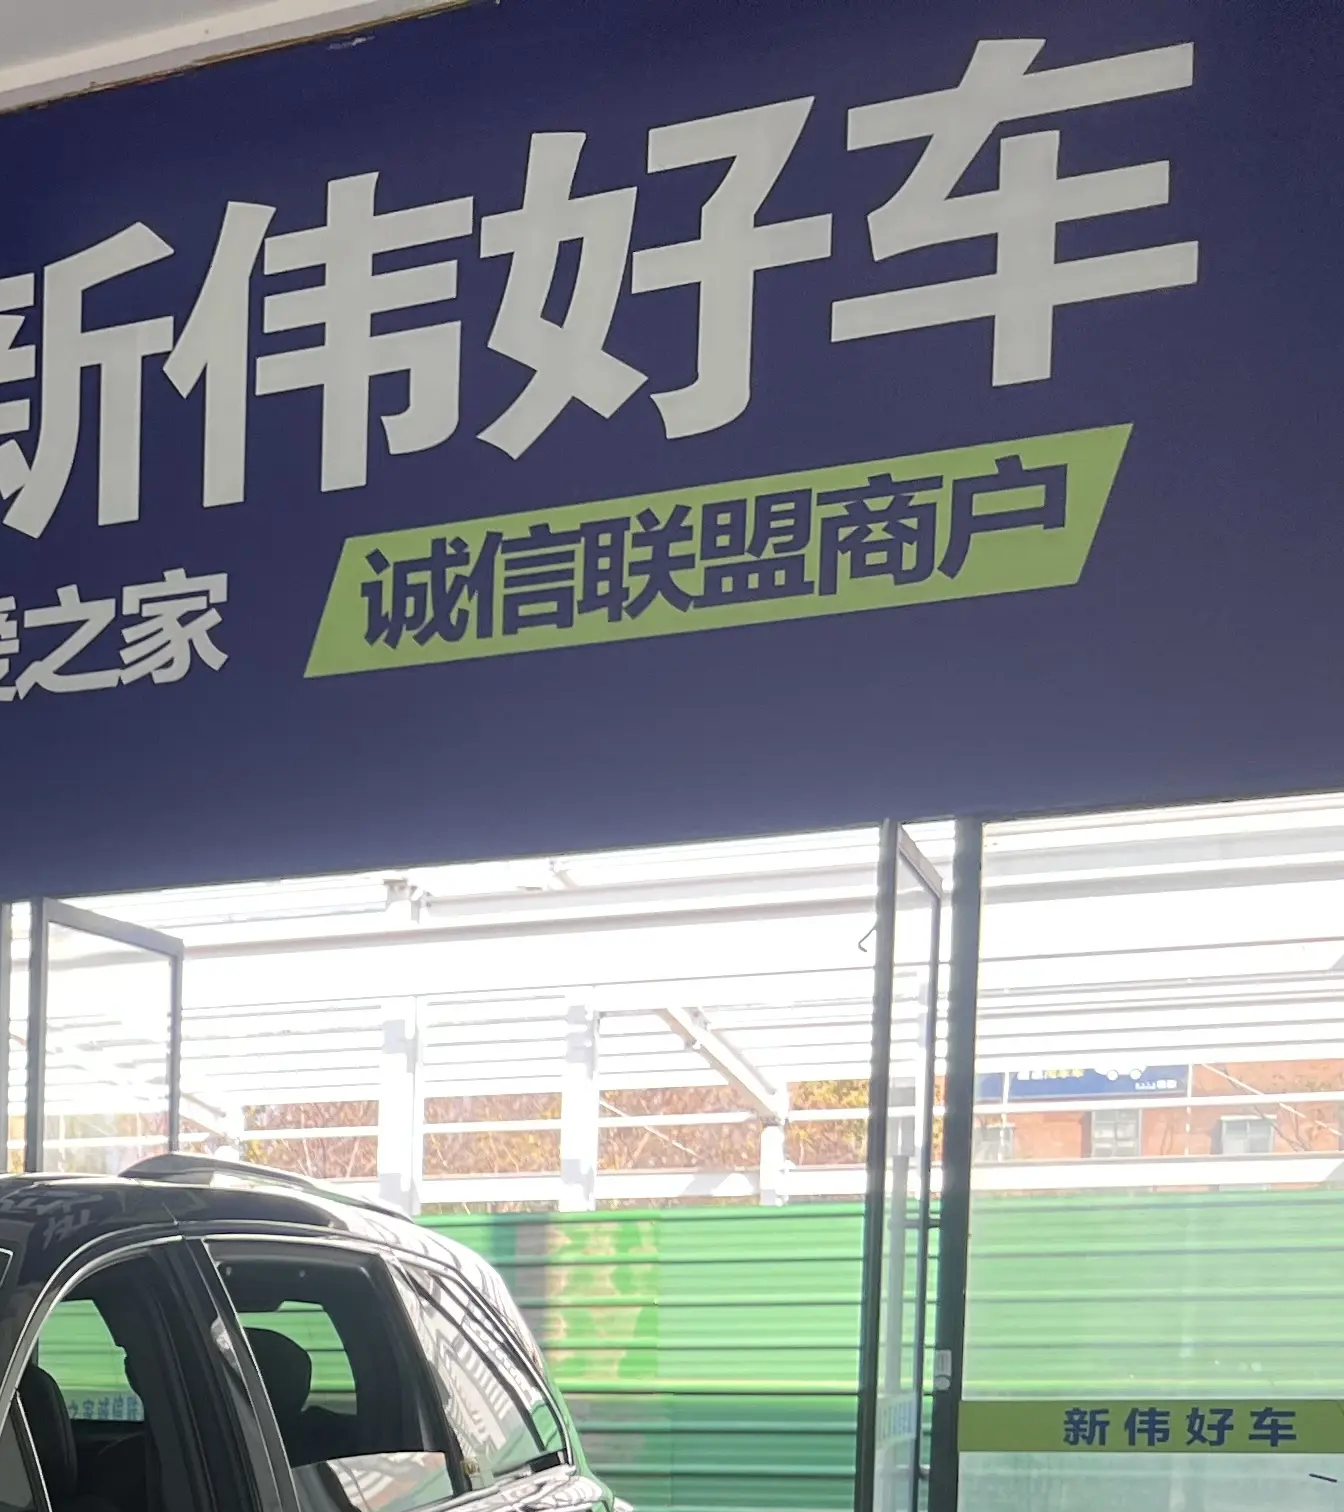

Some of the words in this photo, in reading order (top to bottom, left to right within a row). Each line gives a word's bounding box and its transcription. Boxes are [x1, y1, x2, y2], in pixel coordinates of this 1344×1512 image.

[359, 455, 1068, 653] 诚信联盟商户
[1063, 1406, 1298, 1448] 新伟好车
